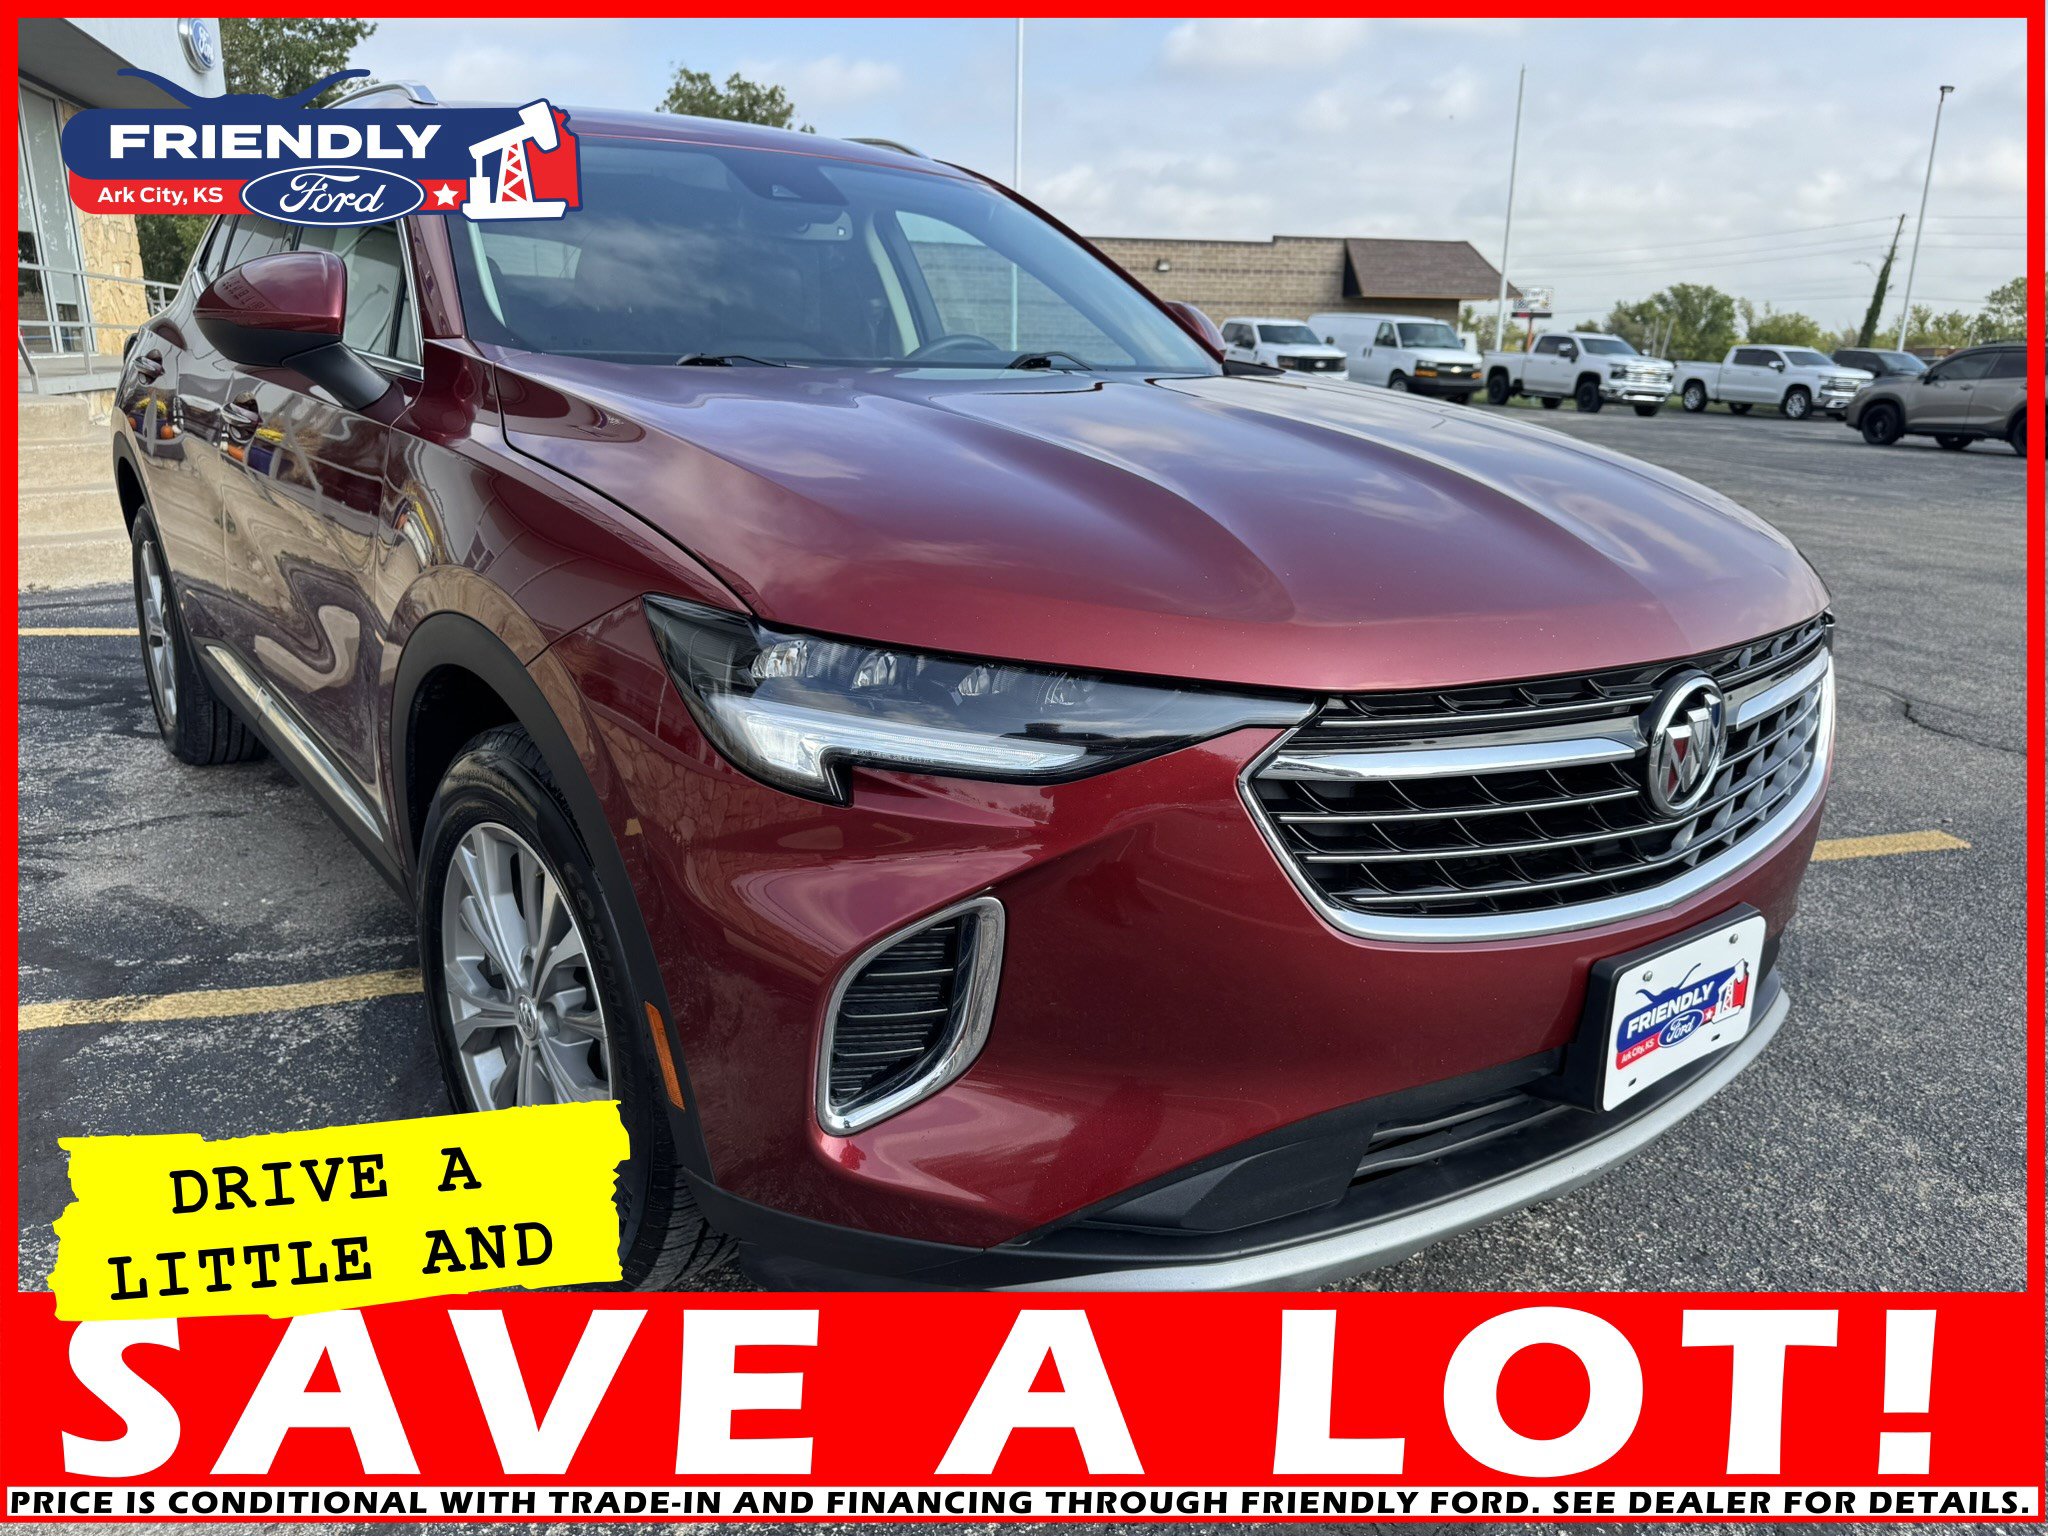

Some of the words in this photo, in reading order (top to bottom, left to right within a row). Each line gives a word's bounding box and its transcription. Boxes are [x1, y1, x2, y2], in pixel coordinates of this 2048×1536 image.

[198, 26, 215, 61] Ford
[1626, 980, 1715, 1039] FRIENDLY
[1666, 1014, 1696, 1043] Ford
